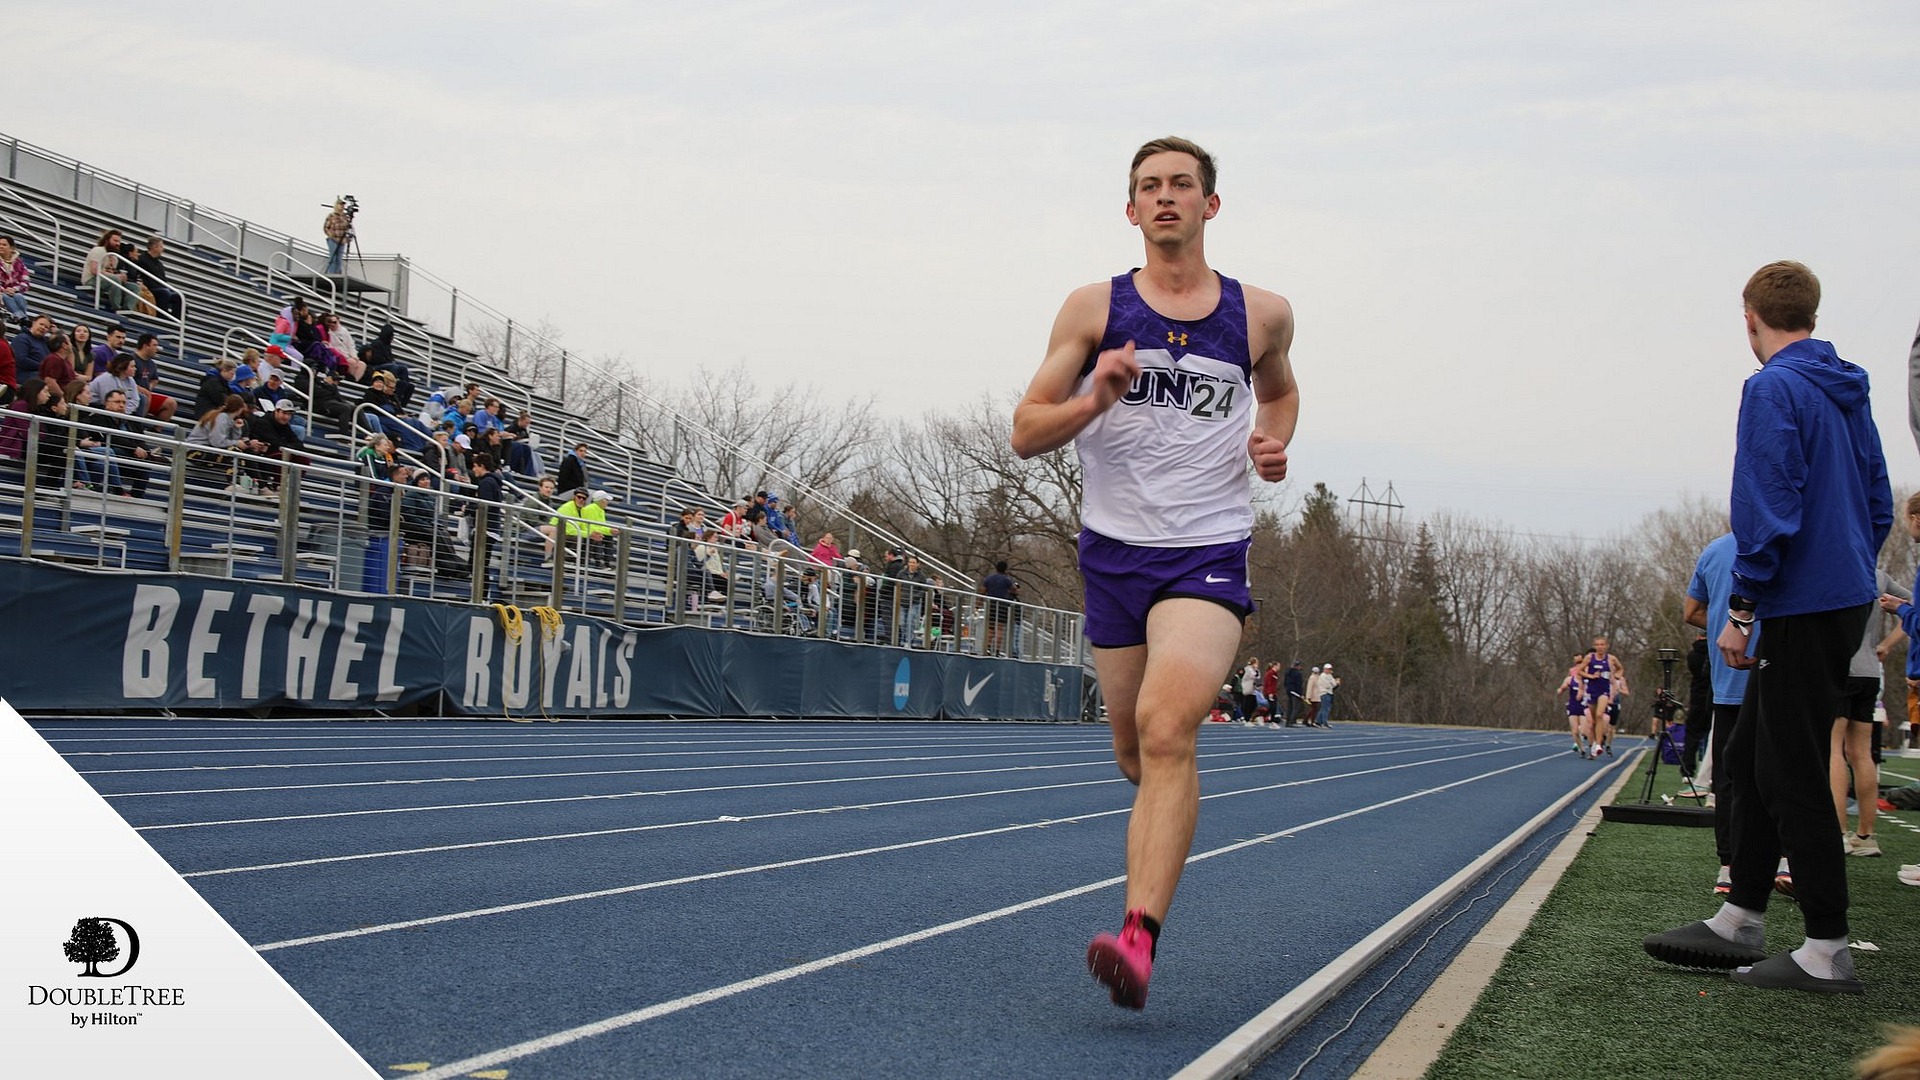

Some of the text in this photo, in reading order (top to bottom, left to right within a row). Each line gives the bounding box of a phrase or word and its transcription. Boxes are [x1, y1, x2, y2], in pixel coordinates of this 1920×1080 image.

[1120, 366, 1239, 410] UN
[1191, 383, 1235, 418] 24
[122, 584, 637, 709] BETHEL ROYALS
